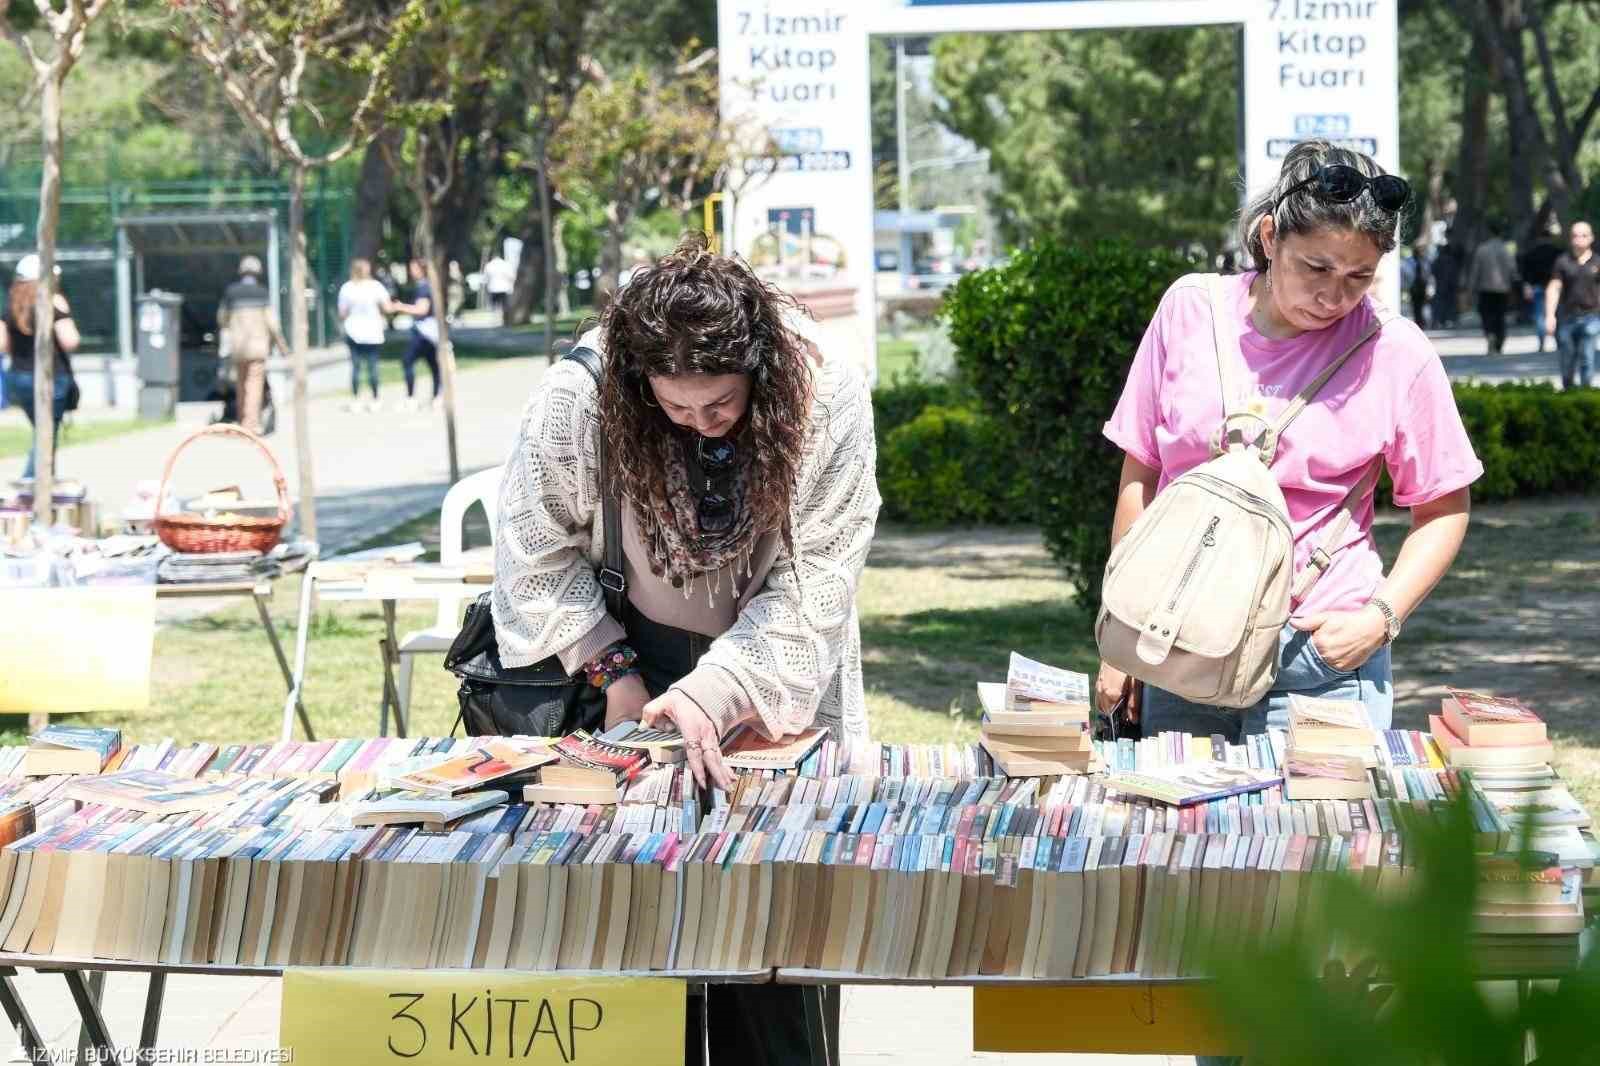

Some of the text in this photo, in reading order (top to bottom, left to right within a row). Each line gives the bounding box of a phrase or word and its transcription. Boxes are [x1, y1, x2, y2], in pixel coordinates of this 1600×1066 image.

[1279, 30, 1366, 58] Kitap
[750, 47, 836, 72] Kitap
[1279, 63, 1364, 87] Fuarı
[388, 989, 603, 1063] 3 KİTAP
